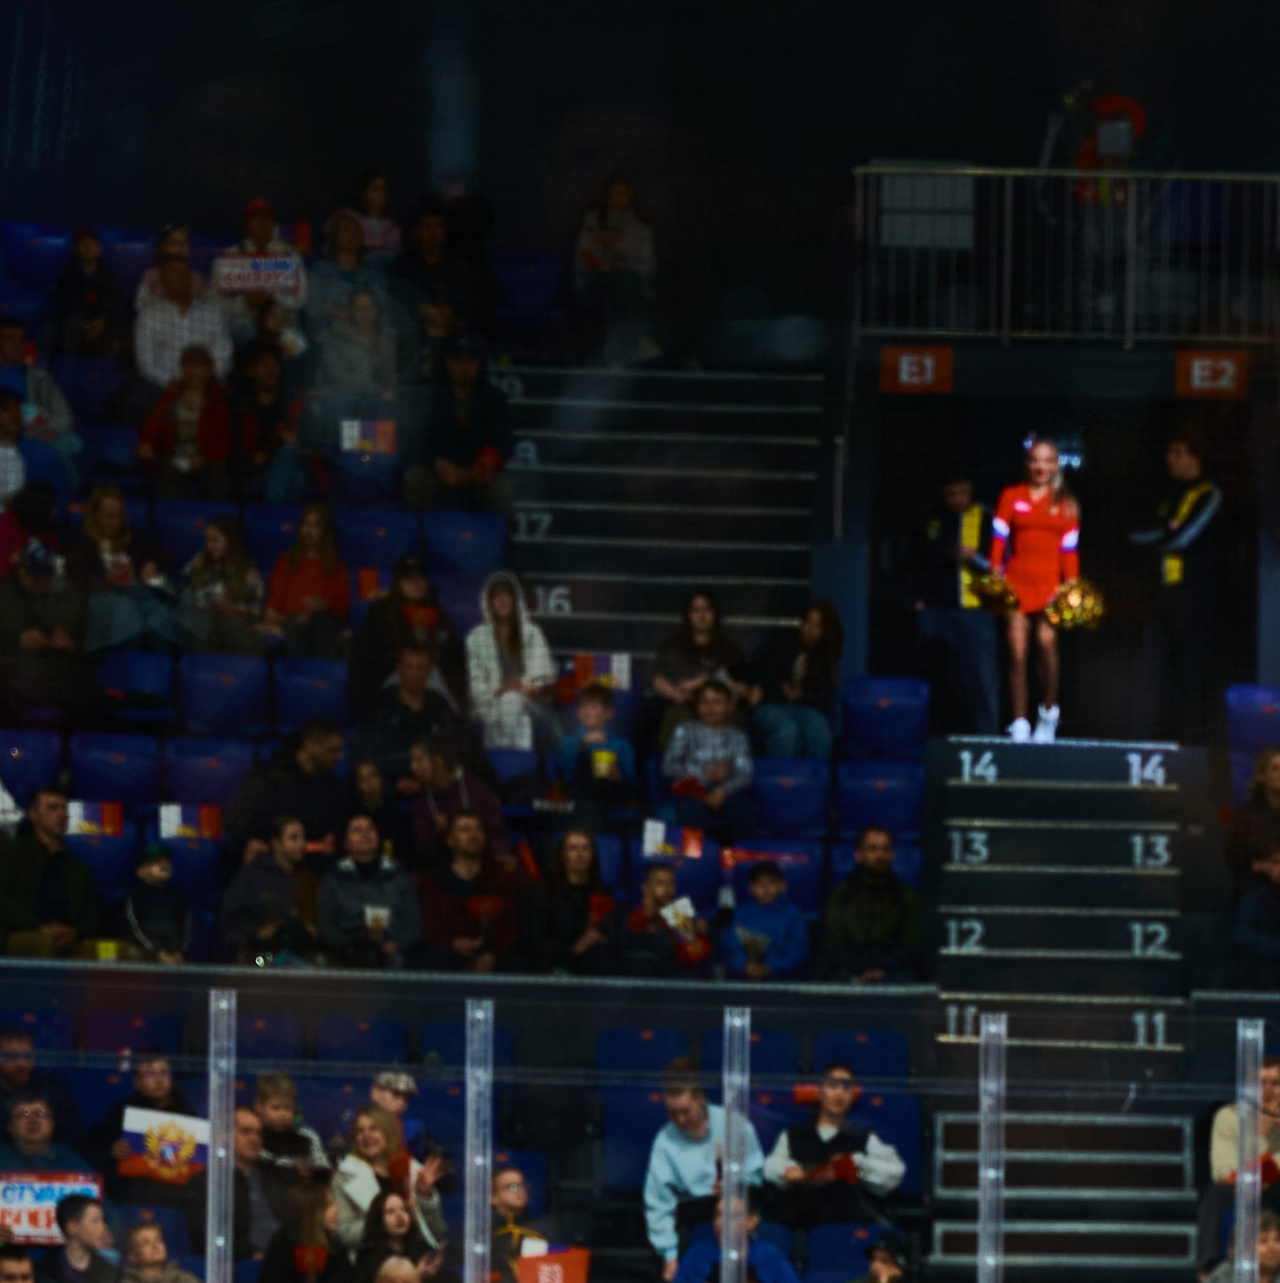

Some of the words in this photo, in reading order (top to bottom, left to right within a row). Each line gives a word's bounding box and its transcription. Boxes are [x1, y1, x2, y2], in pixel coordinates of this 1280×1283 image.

[899, 354, 936, 385] E1
[1190, 359, 1237, 390] E2
[515, 512, 554, 540] 17
[533, 585, 573, 616] 16
[959, 750, 999, 784] 14
[1126, 752, 1166, 787] 14
[950, 830, 989, 864] 13
[1129, 834, 1171, 868] 13
[946, 919, 985, 953] 12
[1129, 921, 1169, 957] 12
[1132, 1011, 1166, 1048] 11
